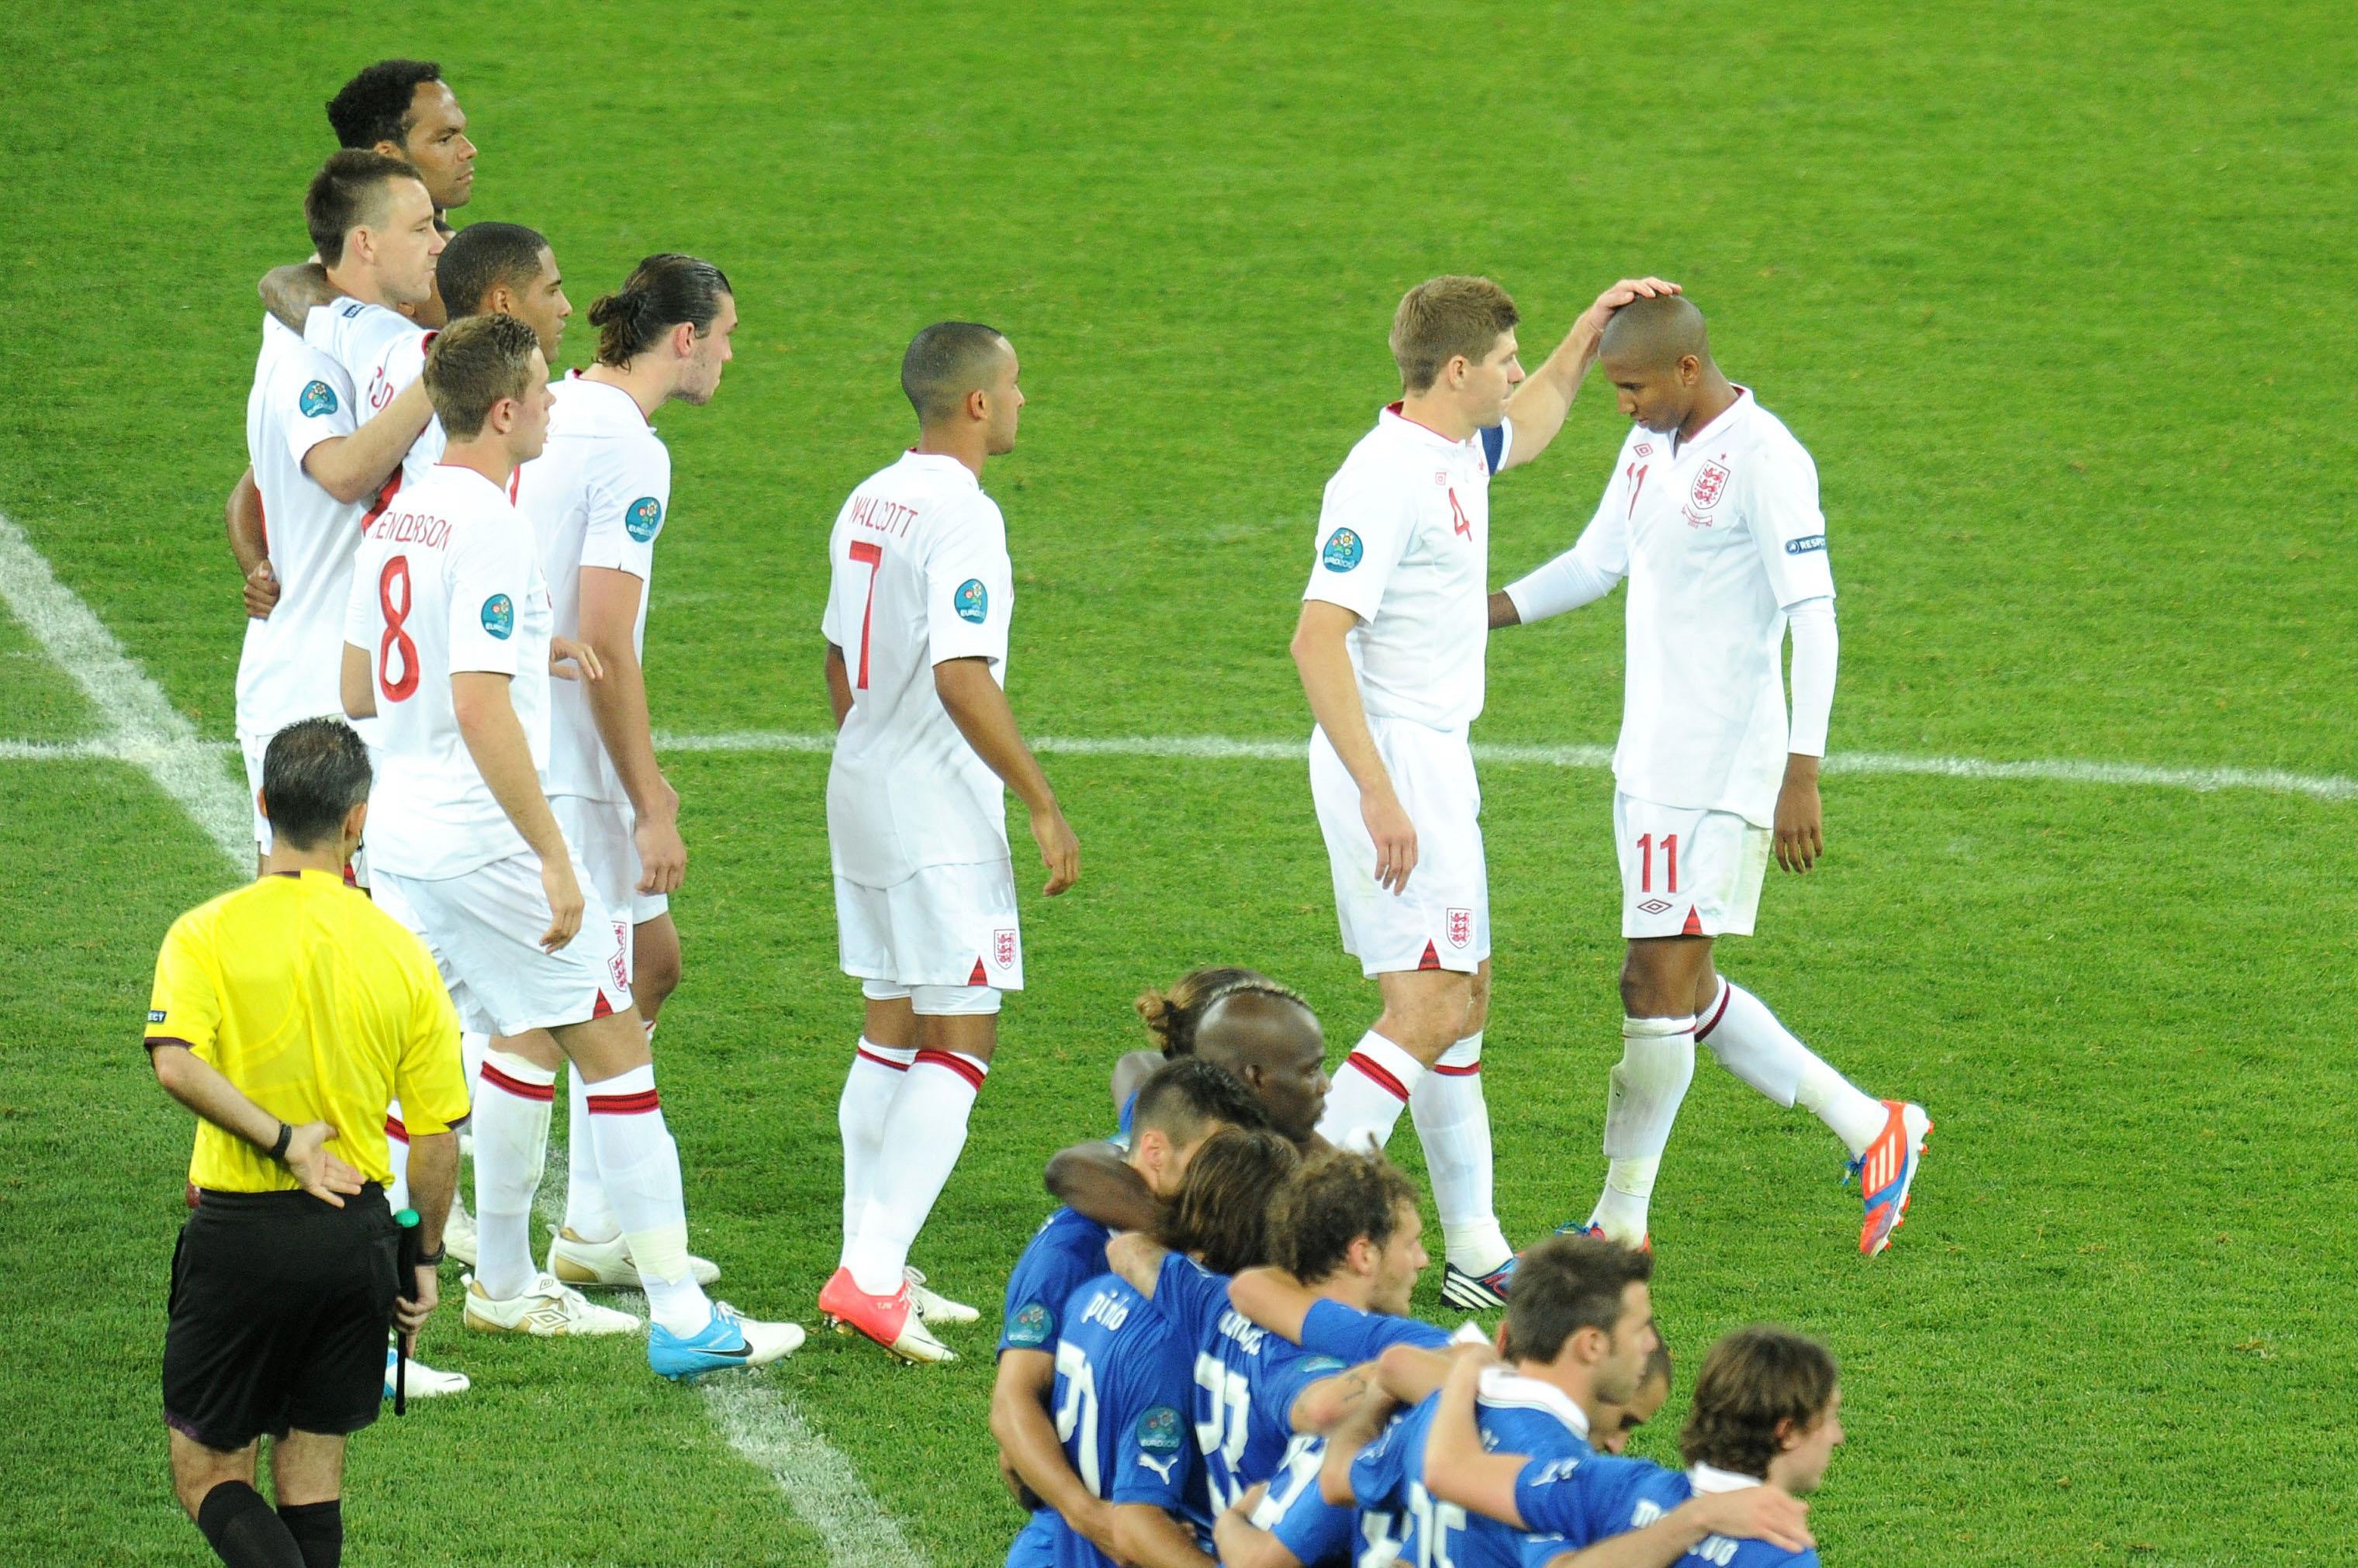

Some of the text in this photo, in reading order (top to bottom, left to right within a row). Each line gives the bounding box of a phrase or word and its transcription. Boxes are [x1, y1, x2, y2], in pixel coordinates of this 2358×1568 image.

[1448, 487, 1472, 542] 4
[380, 555, 420, 702] 8
[849, 540, 883, 690] 7
[1637, 833, 1678, 893] 11
